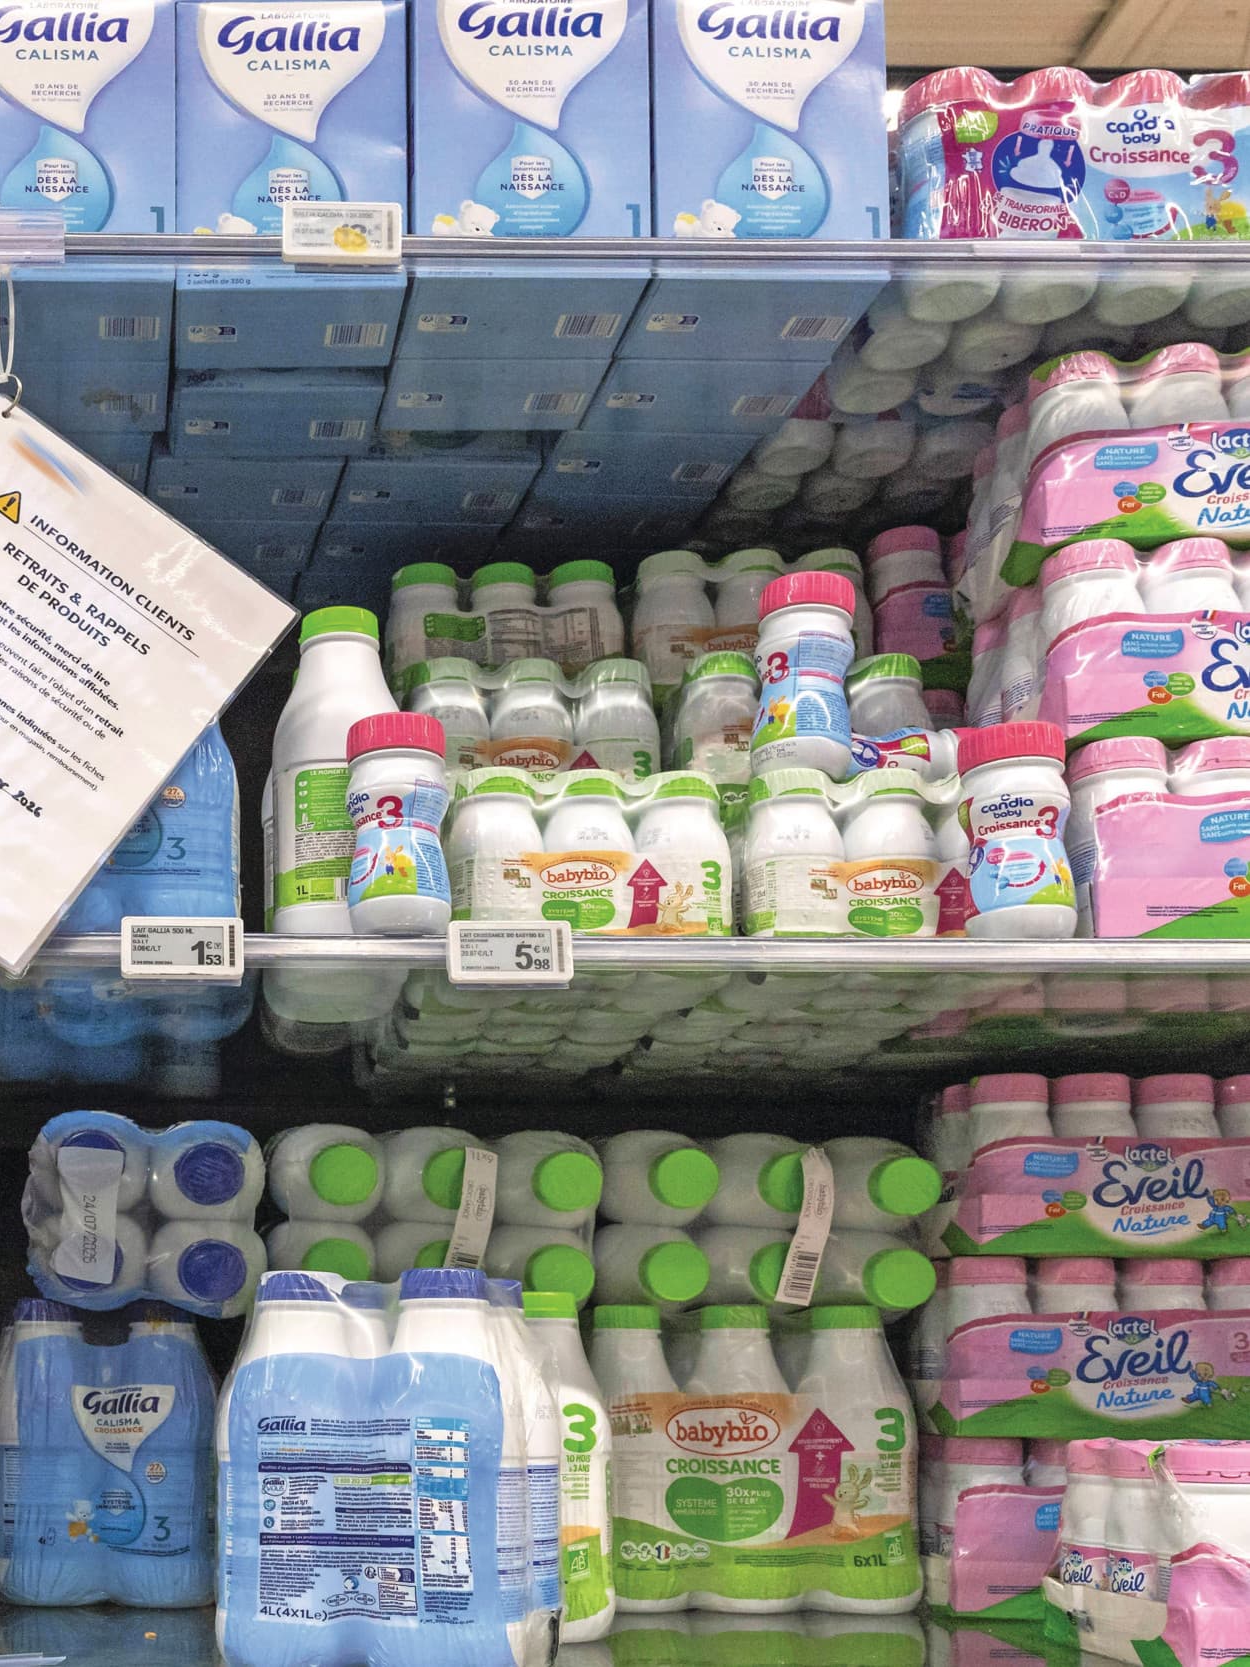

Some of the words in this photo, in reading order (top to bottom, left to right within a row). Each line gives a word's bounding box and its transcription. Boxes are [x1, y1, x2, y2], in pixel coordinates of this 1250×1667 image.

[698, 2, 840, 42] Gallia
[15, 48, 99, 62] CALISMA
[729, 46, 812, 60] CALISMA
[1023, 122, 1078, 137] PRATIQUE
[1089, 146, 1190, 164] Croissance
[1193, 130, 1239, 185] 3
[25, 184, 89, 194] NAISSANCE
[62, 174, 77, 184] LA
[997, 211, 1069, 232] BIBERON
[29, 514, 135, 597] INFORMATION
[134, 593, 196, 641] CLIENTS
[2, 541, 70, 594] RETRAITS
[68, 592, 82, 607] &
[85, 602, 151, 656] RAPPELS
[16, 573, 42, 594] DE
[37, 589, 111, 647] PRODUITS
[14, 613, 53, 646] sécurité,
[52, 642, 83, 666] merci
[80, 662, 94, 674] de
[92, 669, 111, 688] lire
[6, 621, 22, 637] les
[19, 632, 79, 679] informations
[78, 675, 119, 711] affichées.
[8, 664, 39, 689] raisons
[37, 687, 51, 698] de
[50, 695, 84, 723] sécurité
[81, 716, 95, 731] ou
[94, 729, 106, 741] de
[27, 662, 48, 681] faire
[45, 676, 76, 703] l'objet
[72, 696, 95, 716] d'un
[93, 712, 124, 738] retrait
[8, 723, 19, 733] en
[17, 729, 46, 754] magasin,
[15, 710, 58, 745] indiquées
[55, 743, 71, 754] sur
[68, 751, 83, 764] les
[81, 760, 105, 782] fiches
[8, 789, 43, 818] 2026
[981, 797, 1034, 814] candia
[993, 809, 1022, 819] baby
[978, 819, 1041, 836] Croissance
[1036, 807, 1058, 838] 3
[547, 868, 610, 888] babybio
[701, 861, 721, 890] 3
[296, 885, 308, 895] 1L
[542, 889, 613, 898] CROISSANCE
[191, 941, 205, 965] 1
[205, 955, 221, 965] 53
[515, 944, 533, 970] 5
[534, 958, 549, 970] 98
[1125, 1146, 1174, 1163] lactel
[1121, 1201, 1184, 1216] Croissance
[82, 1194, 96, 1264] 24/07/2026
[1112, 1214, 1190, 1233] Nature
[82, 1391, 159, 1415] Gallia
[1096, 1388, 1174, 1409] Nature
[676, 1420, 768, 1446] babybio
[875, 1408, 905, 1451] 3
[666, 1458, 781, 1474] CROISSANCE
